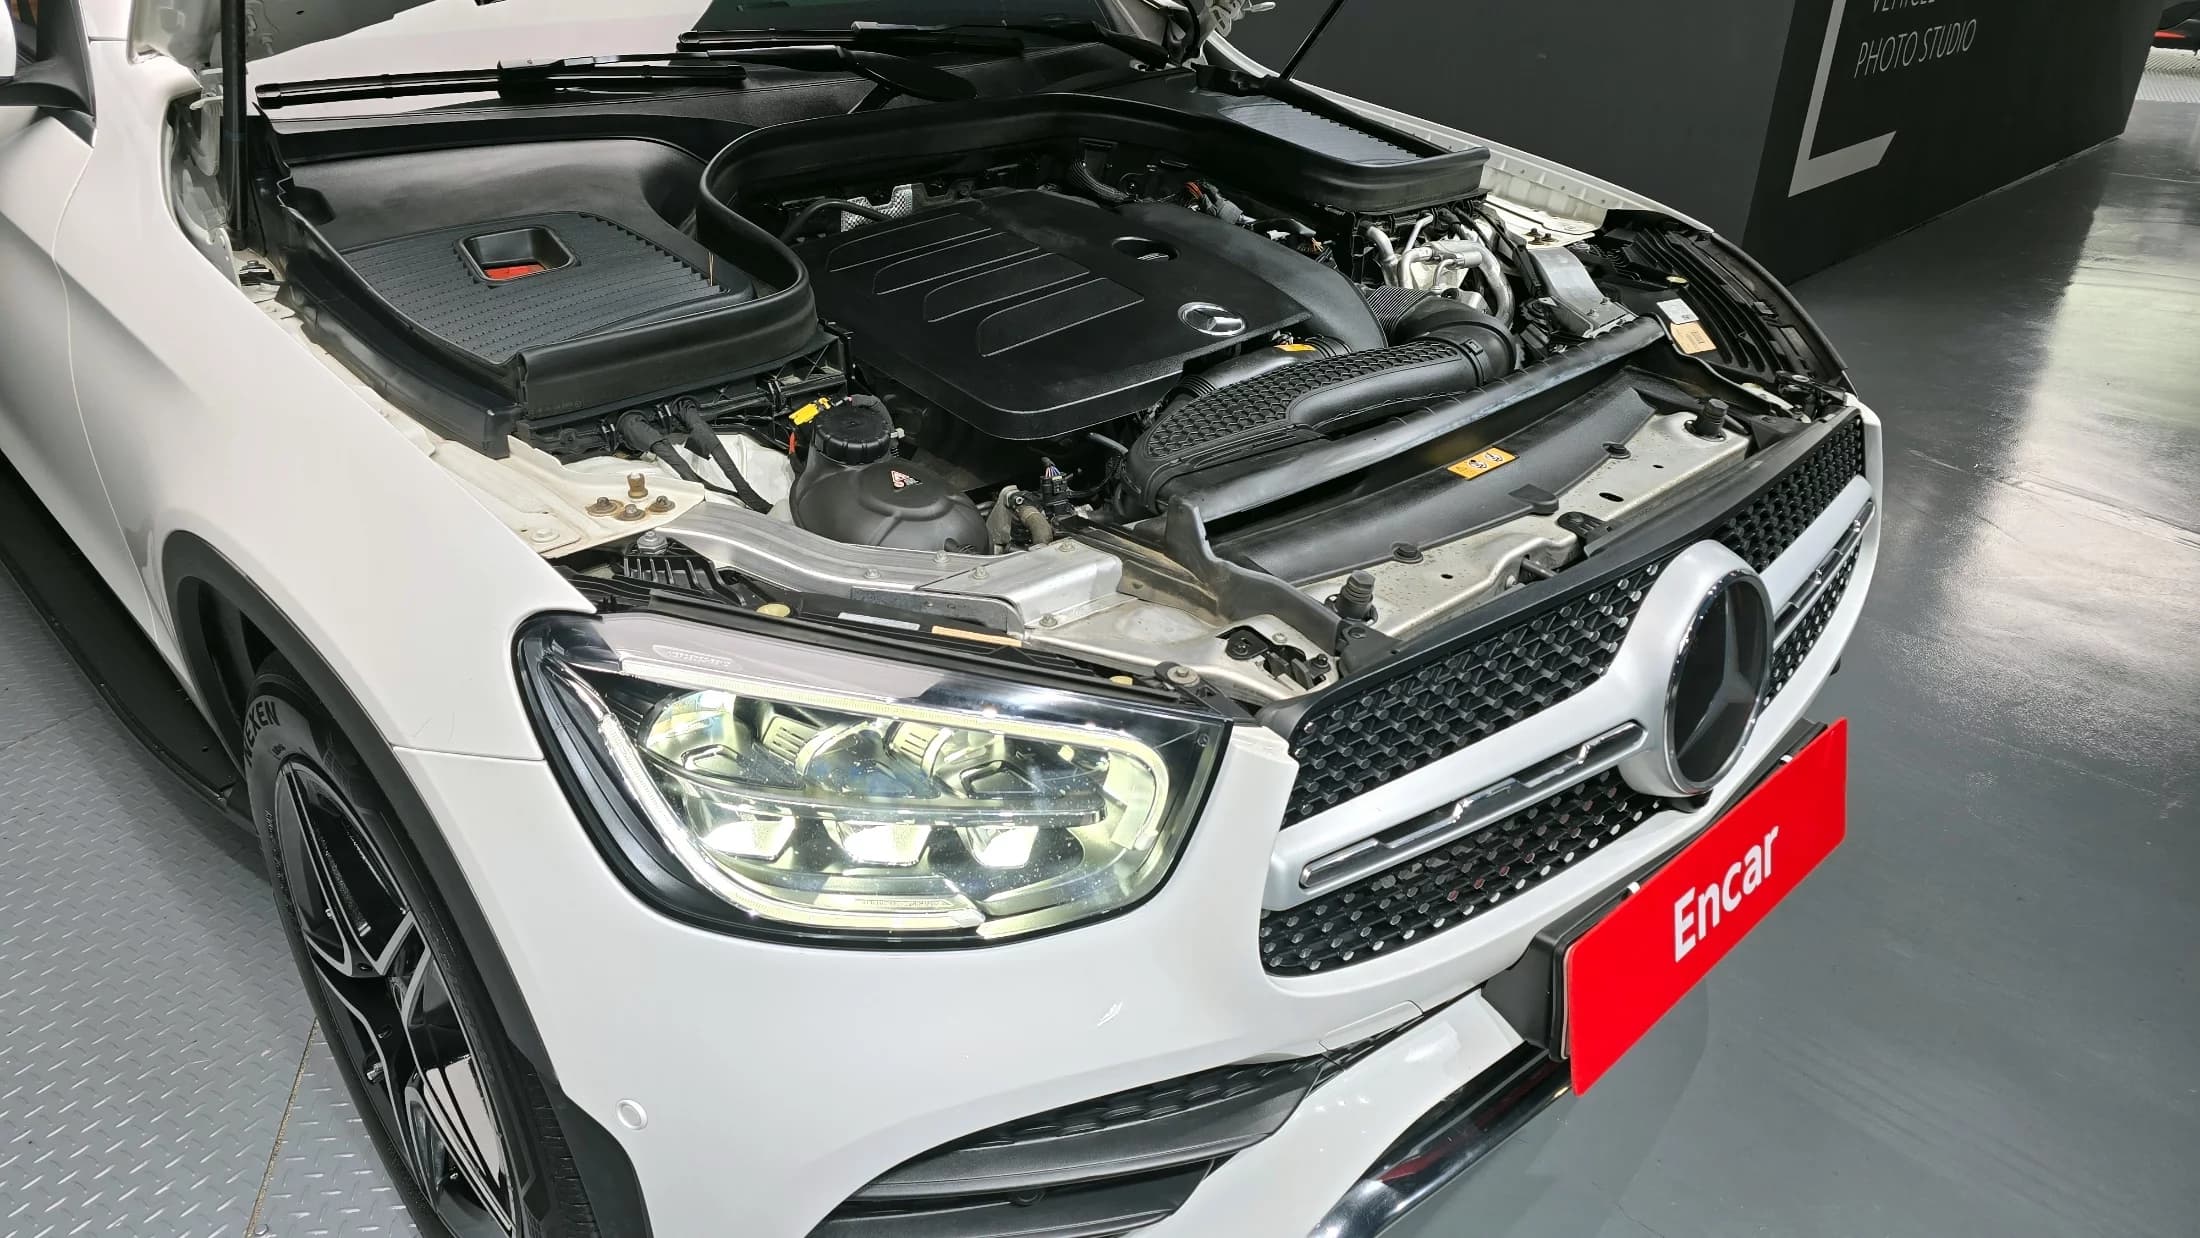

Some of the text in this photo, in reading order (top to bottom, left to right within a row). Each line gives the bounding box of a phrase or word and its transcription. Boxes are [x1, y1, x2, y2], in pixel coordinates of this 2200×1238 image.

[1854, 18, 1977, 79] PHOTO STUDIO
[243, 700, 281, 768] NEXEN
[1673, 825, 1780, 963] Encar
